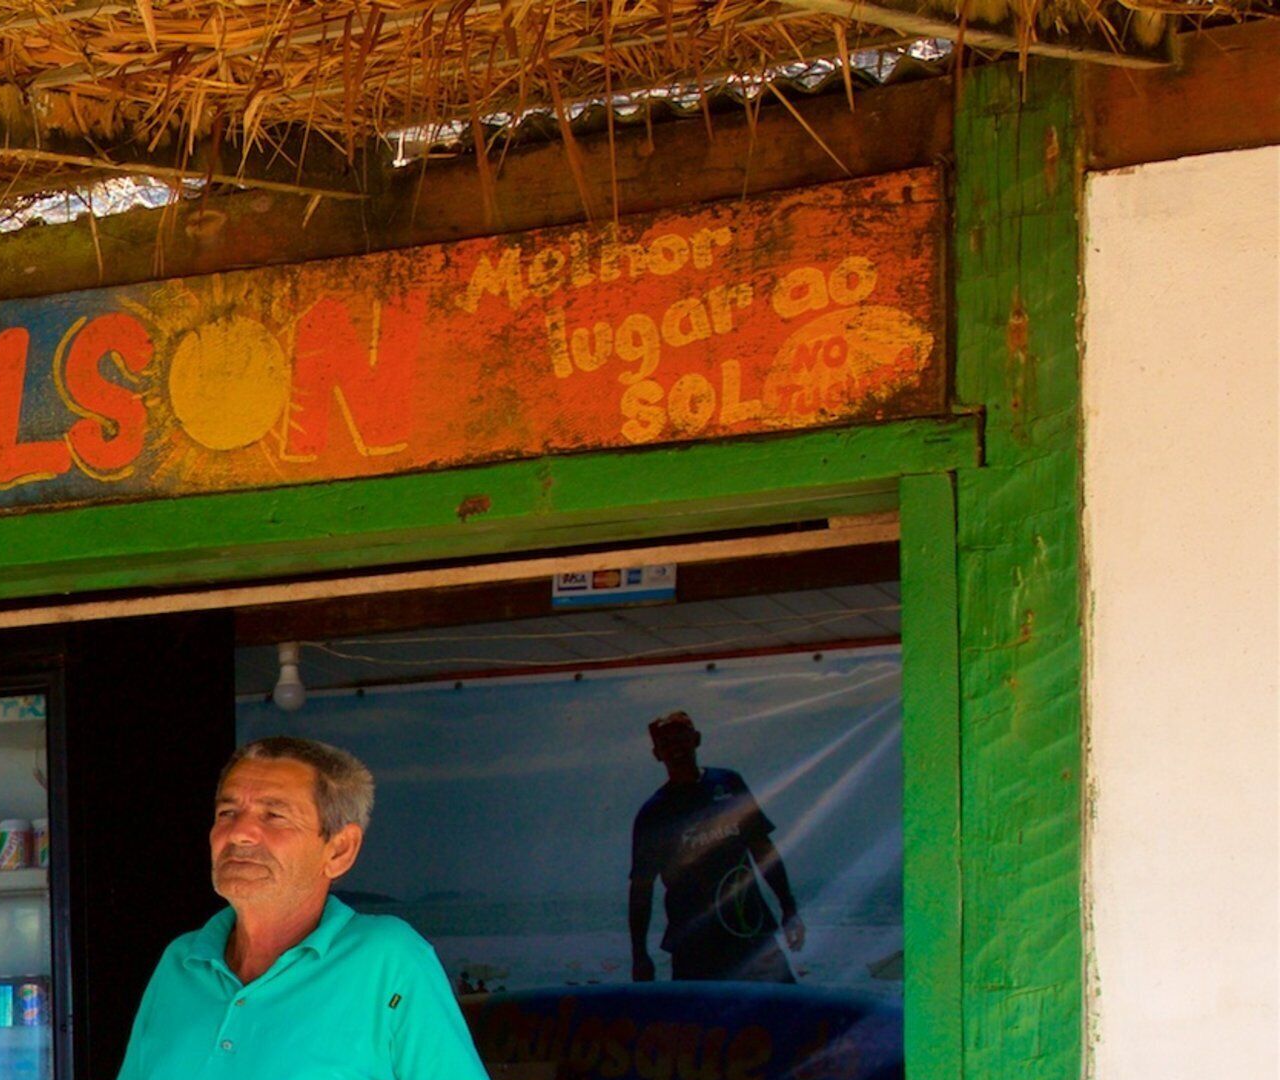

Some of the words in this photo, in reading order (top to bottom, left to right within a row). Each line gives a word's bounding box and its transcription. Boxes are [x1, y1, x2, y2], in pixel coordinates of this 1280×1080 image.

[455, 222, 733, 314] Melhor
[545, 281, 754, 386] lugar
[772, 255, 879, 319] ao
[792, 334, 849, 374] NO
[620, 358, 763, 444] SOL
